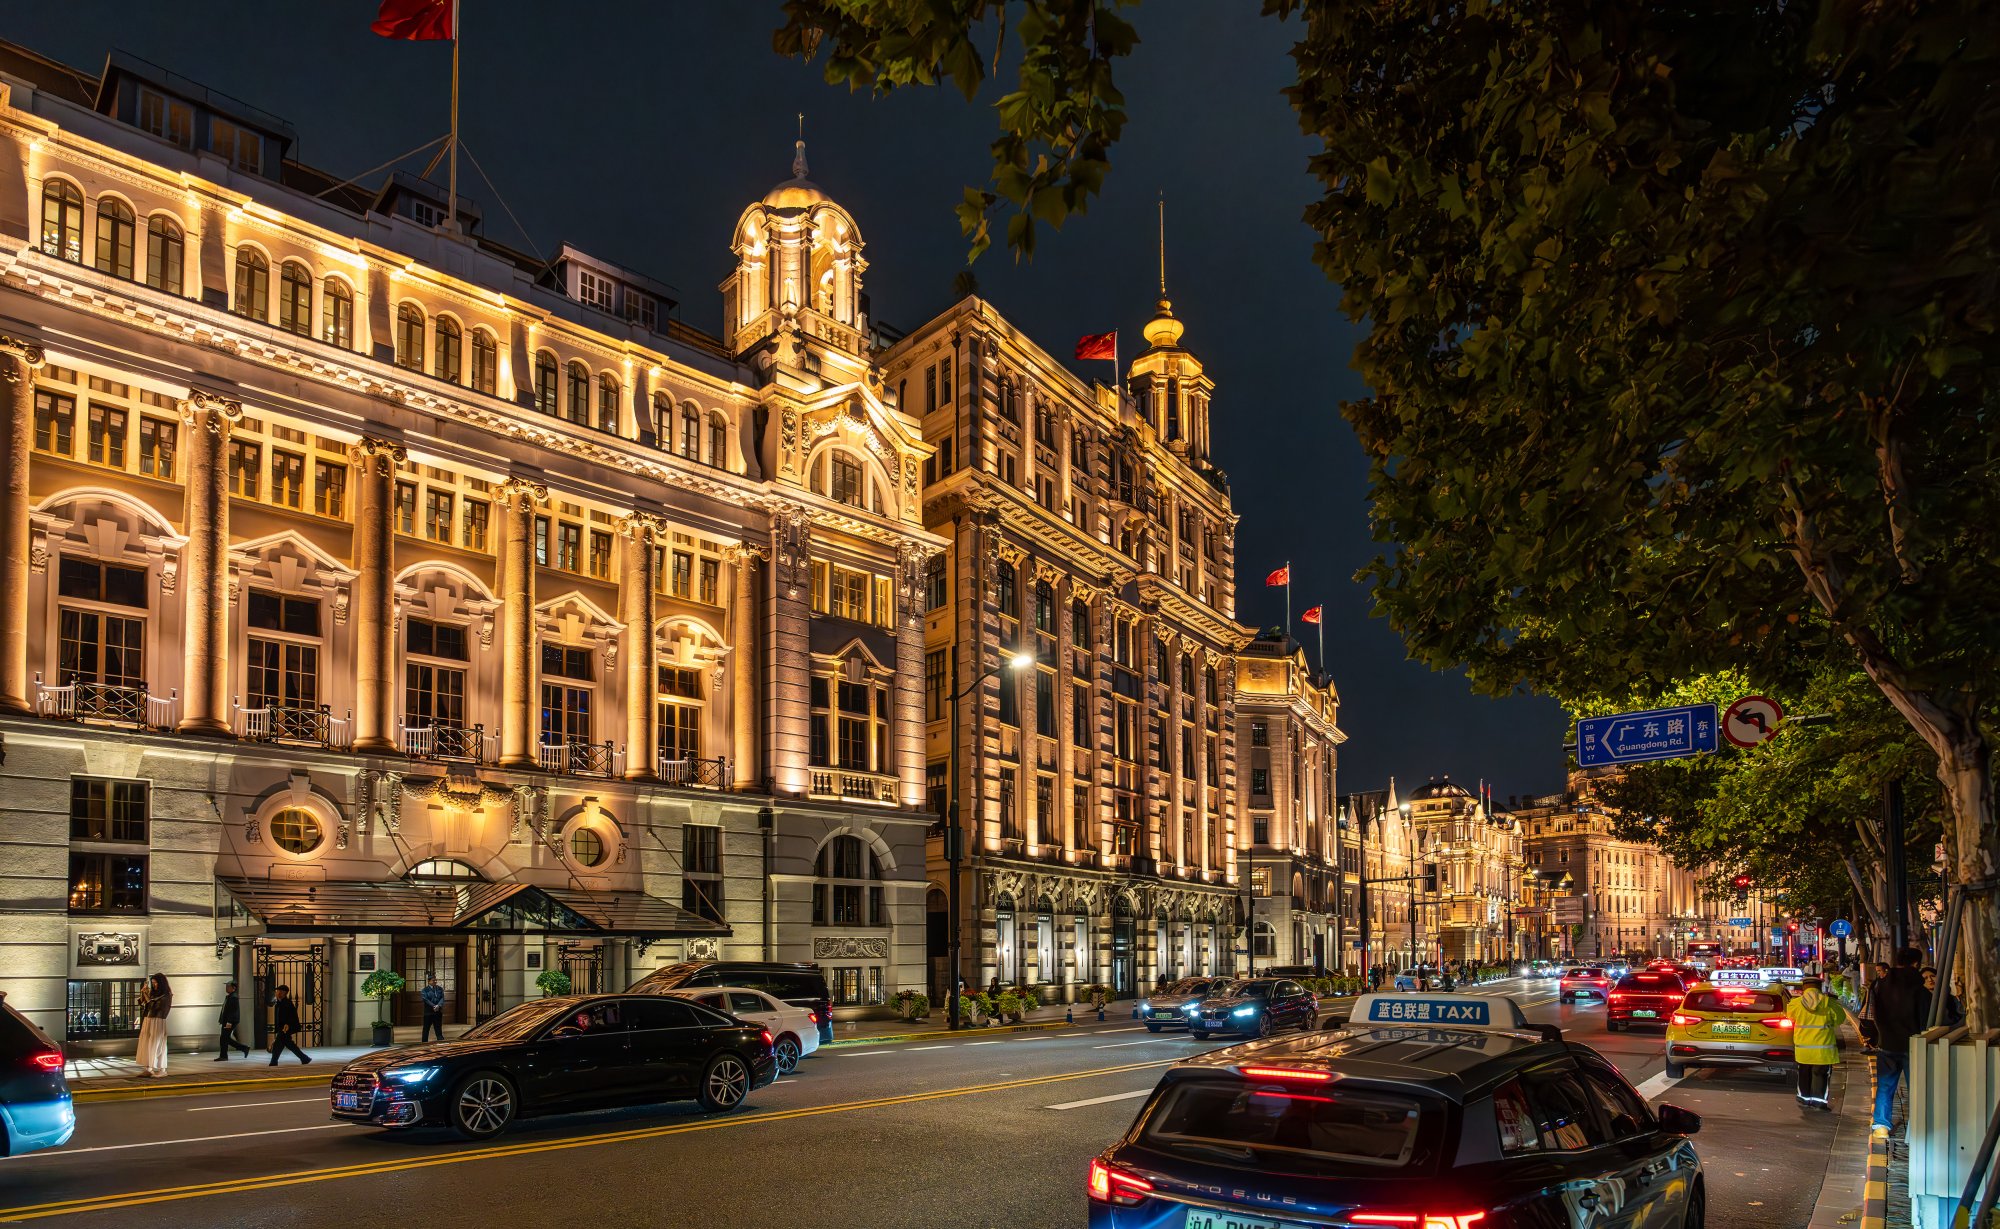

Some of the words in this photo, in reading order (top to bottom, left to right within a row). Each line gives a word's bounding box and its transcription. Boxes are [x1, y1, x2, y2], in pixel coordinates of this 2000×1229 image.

[1619, 718, 1685, 742] 广东路
[1697, 720, 1708, 730] 东
[1585, 734, 1596, 744] 西
[1618, 740, 1668, 751] Guangdong
[1669, 736, 1684, 746] Rd.
[1378, 1002, 1430, 1020] 蓝色联盟
[1436, 1005, 1481, 1019] TAXI
[1187, 1183, 1297, 1205] ROEWE
